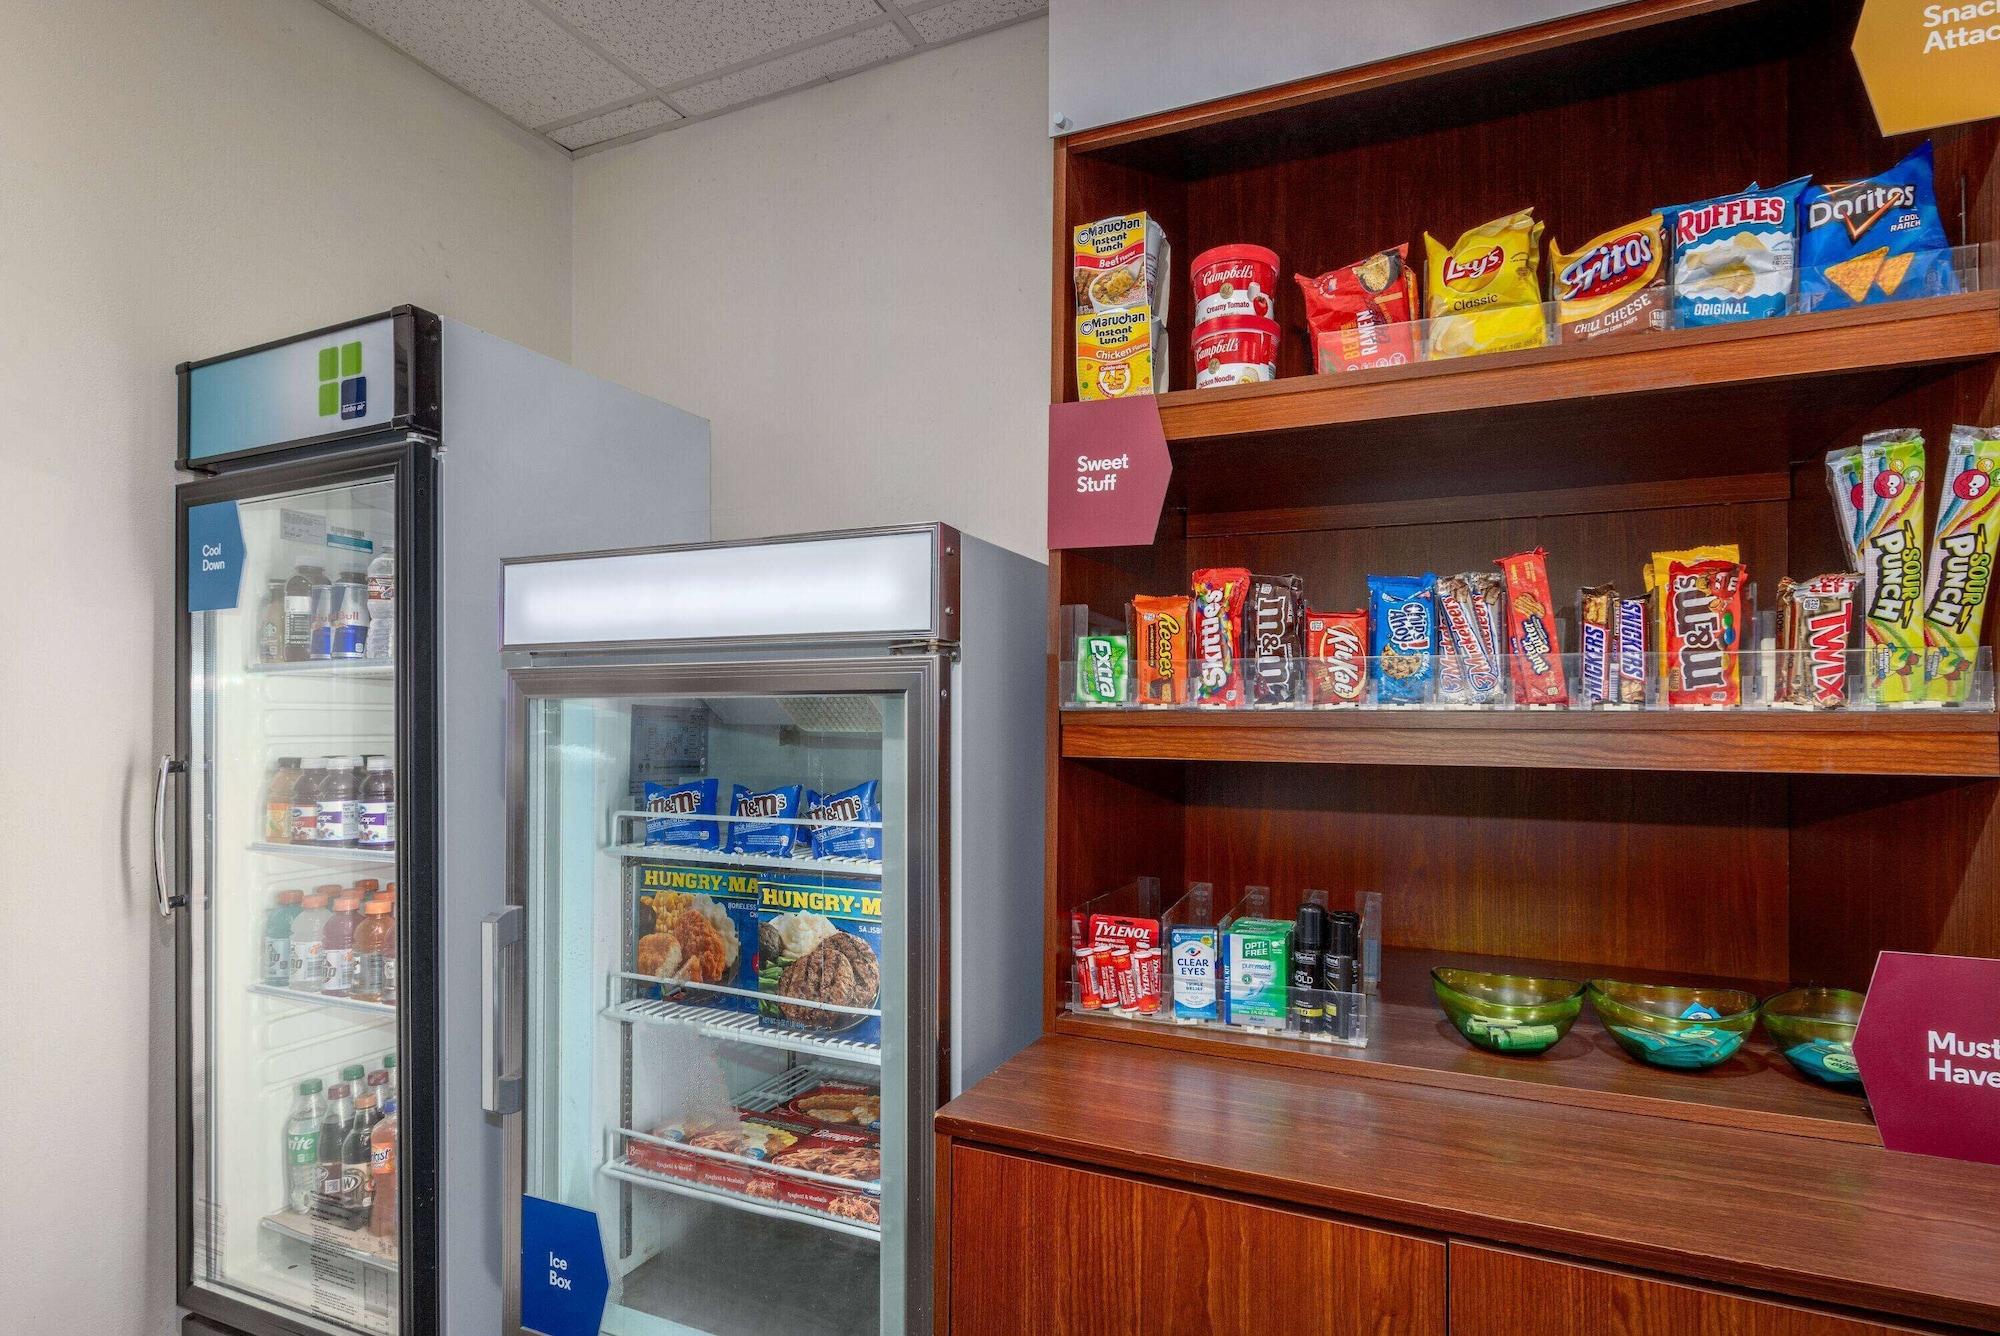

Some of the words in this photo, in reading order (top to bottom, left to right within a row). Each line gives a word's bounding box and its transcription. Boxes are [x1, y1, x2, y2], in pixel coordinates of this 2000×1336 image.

[1922, 0, 2000, 27] Snac
[1923, 25, 2000, 54] Attac
[1809, 185, 1915, 229] Doritos
[1899, 214, 1920, 223] COOL
[1088, 219, 1140, 237] Maruchan
[1677, 198, 1784, 247] RUFFLES
[1890, 220, 1921, 232] RANCH
[1092, 232, 1127, 246] Instant
[1096, 242, 1123, 253] Lunch
[1099, 254, 1120, 268] Beef
[1445, 246, 1502, 281] Lay's
[1560, 233, 1653, 301] Fritos
[1202, 264, 1254, 287] Campbell's
[1206, 303, 1227, 314] Creamy
[1227, 301, 1250, 310] Tomato
[1453, 293, 1498, 311] Classic
[1574, 319, 1600, 334] CHILI
[1604, 293, 1652, 326] CHEESE
[1694, 302, 1750, 316] ORIGINAL
[1091, 313, 1145, 328] Maruchan
[1096, 325, 1132, 337] Instant
[1100, 335, 1128, 345] Lunch
[1195, 337, 1239, 362] Campbell's
[1096, 347, 1132, 360] Chicken
[1103, 369, 1127, 384] 45
[1214, 374, 1236, 384] Noodle
[1077, 453, 1128, 472] Sweet
[1077, 474, 1117, 493] Stuff
[202, 543, 222, 557] Cool
[202, 559, 226, 572] Down
[1872, 530, 1905, 621] PUNCH
[1901, 548, 1921, 600] SOUR
[1928, 534, 1976, 626] PUNCH
[1961, 553, 1991, 605] SOUR
[1389, 609, 1430, 651] Ahoy!
[1402, 603, 1426, 640] Chips
[1158, 612, 1181, 679] Reese's
[1201, 588, 1228, 688] Skittles
[1441, 595, 1491, 675] Musketeers
[1523, 620, 1551, 654] Butter
[1620, 600, 1643, 680] SNICKERS
[1521, 639, 1549, 675] Nutter
[1808, 600, 1853, 702] TWIX
[1090, 640, 1116, 698] Extra
[644, 869, 758, 894] HUNGRY-MA
[762, 888, 882, 916] HUNGRY-M
[1095, 921, 1151, 940] TYLENOL
[1244, 941, 1268, 950] OPTI-
[1245, 948, 1268, 957] FREE
[1177, 958, 1209, 967] CLEAR
[1181, 967, 1206, 976] EYES
[1124, 969, 1137, 1003] TYLENOL
[1141, 962, 1152, 995] TYLENOL
[1928, 1030, 2000, 1060] Must
[1928, 1058, 2000, 1089] Have
[288, 1136, 314, 1151] rite
[371, 1148, 391, 1161] kist
[549, 1251, 568, 1271] Ice
[549, 1269, 572, 1291] Box
